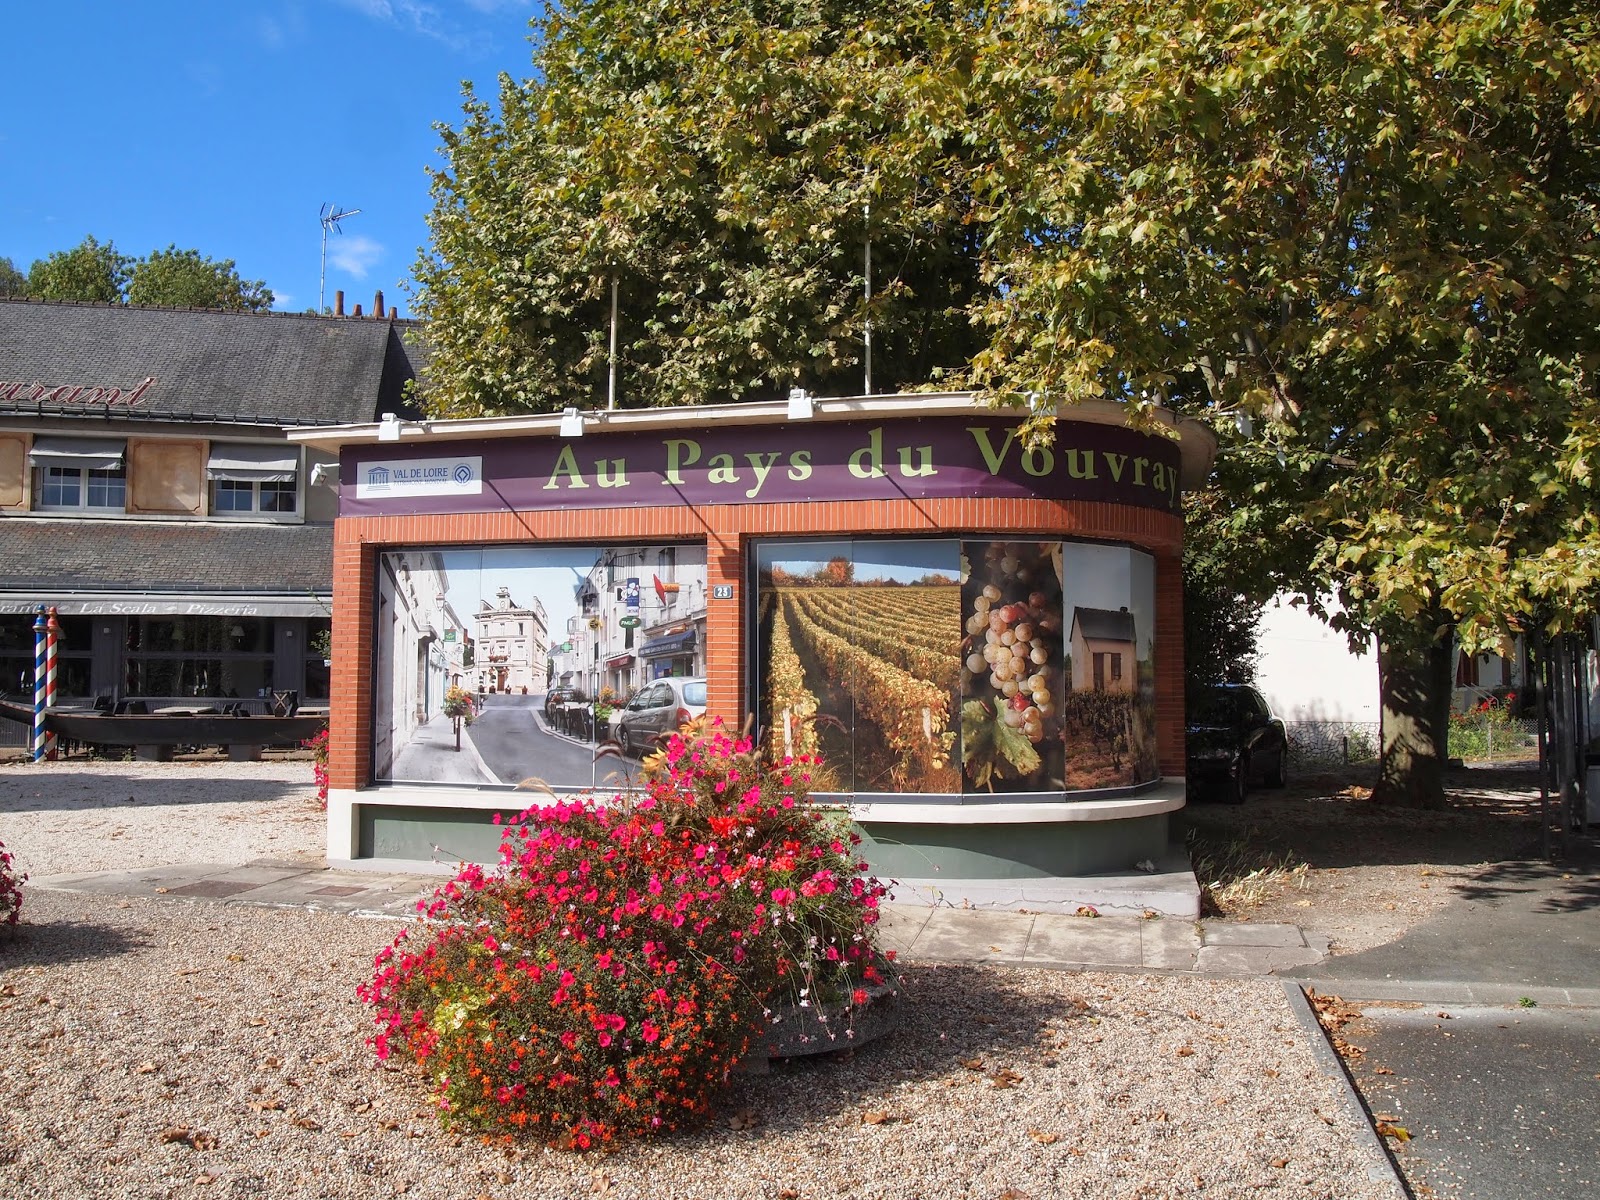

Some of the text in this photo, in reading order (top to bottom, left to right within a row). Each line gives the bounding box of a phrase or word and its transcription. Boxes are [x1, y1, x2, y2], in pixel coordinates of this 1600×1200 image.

[393, 469, 408, 479] VAL
[411, 468, 421, 478] DE
[424, 467, 448, 478] LOIRE
[542, 426, 1177, 508] Au Pays du Vouvray
[717, 587, 728, 597] 23
[80, 602, 102, 613] La
[109, 603, 156, 614] Scala
[186, 603, 257, 615] Pizzeria
